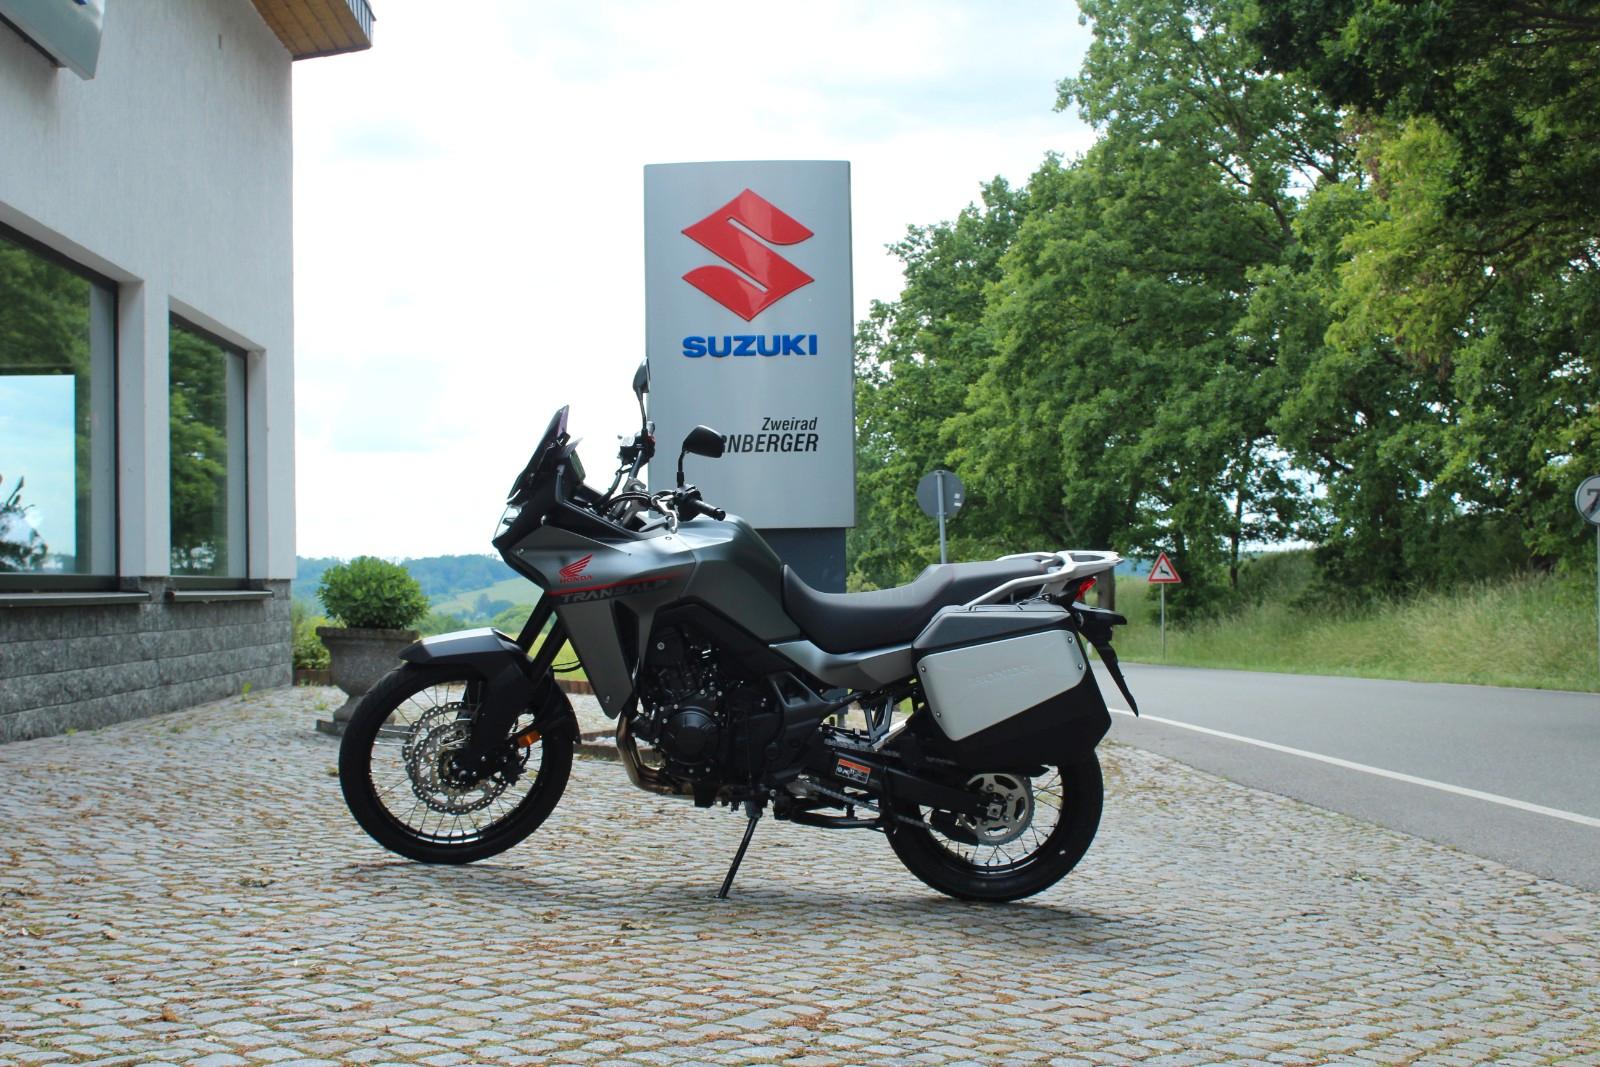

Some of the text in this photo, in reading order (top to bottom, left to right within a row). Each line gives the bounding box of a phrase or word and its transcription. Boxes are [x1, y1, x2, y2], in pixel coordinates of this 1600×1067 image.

[682, 334, 818, 358] SUZUKI
[761, 416, 818, 431] Zweirad
[560, 574, 592, 584] HONDA
